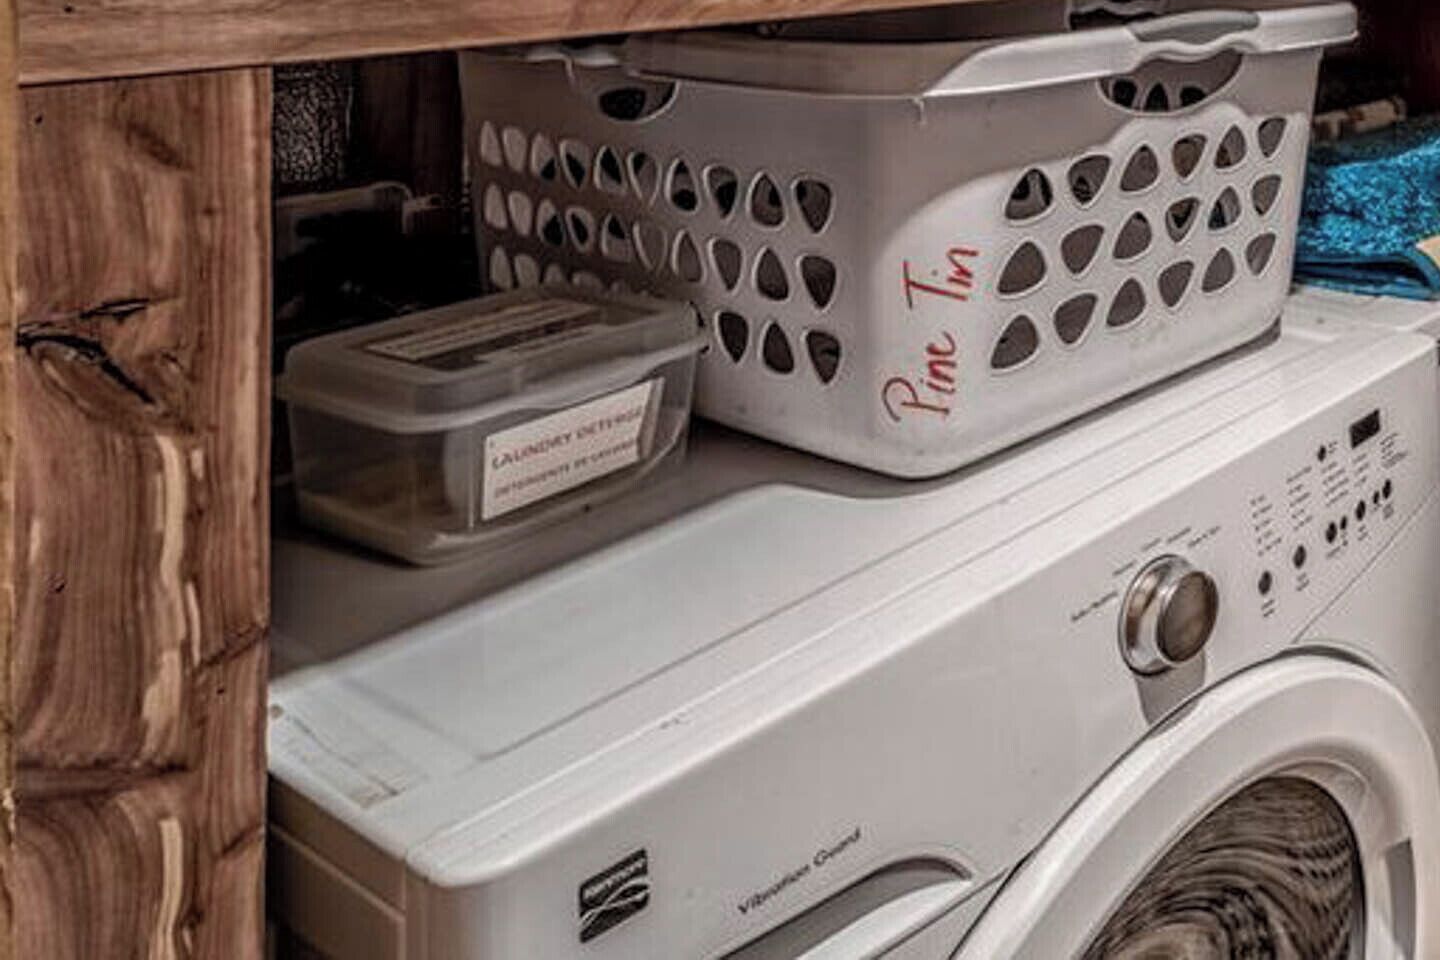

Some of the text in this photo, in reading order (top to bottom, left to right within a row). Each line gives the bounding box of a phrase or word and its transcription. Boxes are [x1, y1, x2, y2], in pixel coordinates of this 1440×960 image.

[881, 247, 979, 422] Pine Tin
[491, 431, 573, 470] LAUNDRY
[737, 826, 861, 915] Vibration Guard
